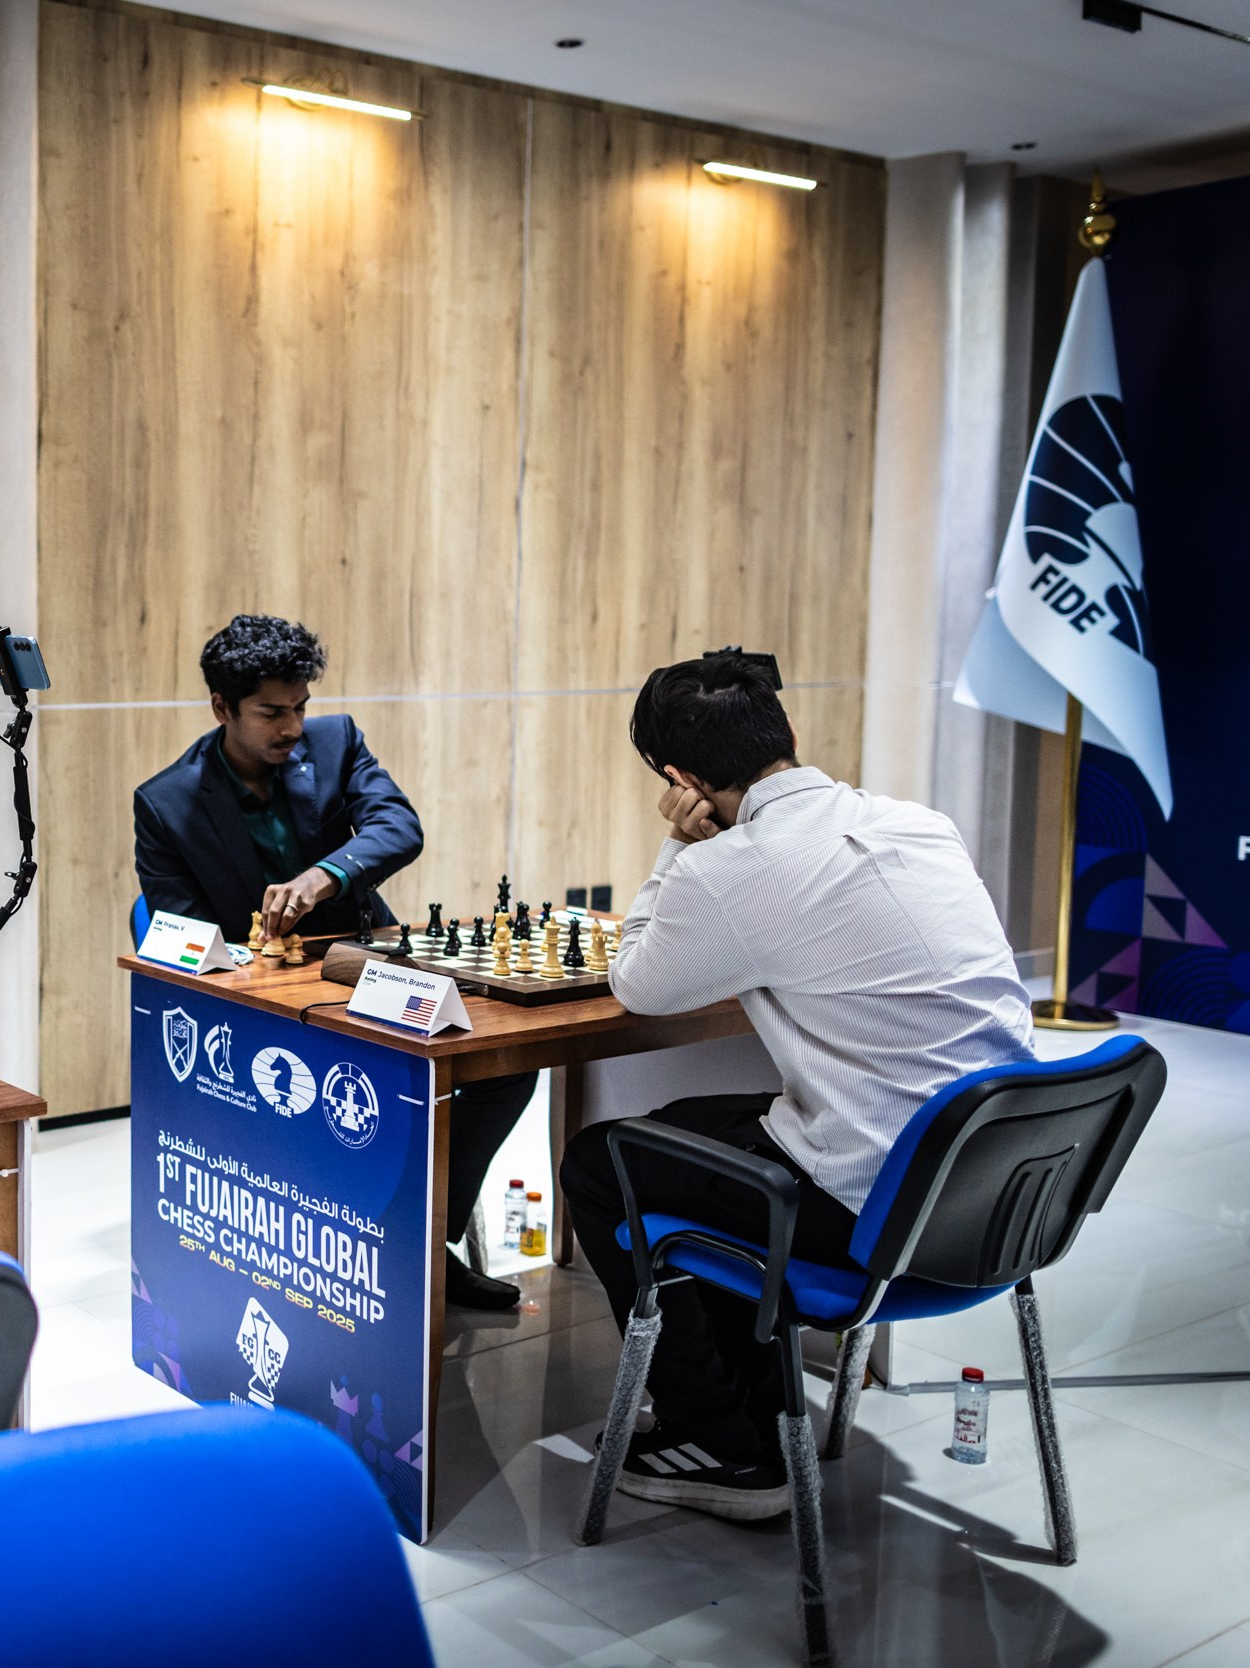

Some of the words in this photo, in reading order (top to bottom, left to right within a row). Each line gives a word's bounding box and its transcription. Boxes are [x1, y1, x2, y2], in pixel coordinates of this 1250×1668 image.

[1030, 565, 1106, 634] FIDE
[367, 968, 378, 976] GM
[378, 971, 408, 985] Jacobson,
[408, 978, 436, 991] Brandon
[275, 1103, 292, 1118] FIDE
[158, 1130, 205, 1162] للشطرنج
[207, 1155, 238, 1177] الأولى
[240, 1162, 288, 1198] العالمية
[291, 1185, 338, 1219] الفجيرة
[157, 1152, 181, 1193] 1ST
[185, 1164, 285, 1251] FUJAIRAH
[291, 1212, 386, 1298] GLOBAL
[341, 1205, 385, 1245] بطولة
[157, 1198, 215, 1243] CHESS
[219, 1228, 385, 1324] CHAMPIONSHIP
[179, 1234, 205, 1252] 25TH
[209, 1250, 236, 1272] AUG
[252, 1271, 281, 1290] 02ND
[285, 1287, 313, 1309] SEP
[317, 1304, 356, 1334] 2025
[268, 1348, 280, 1364] CC
